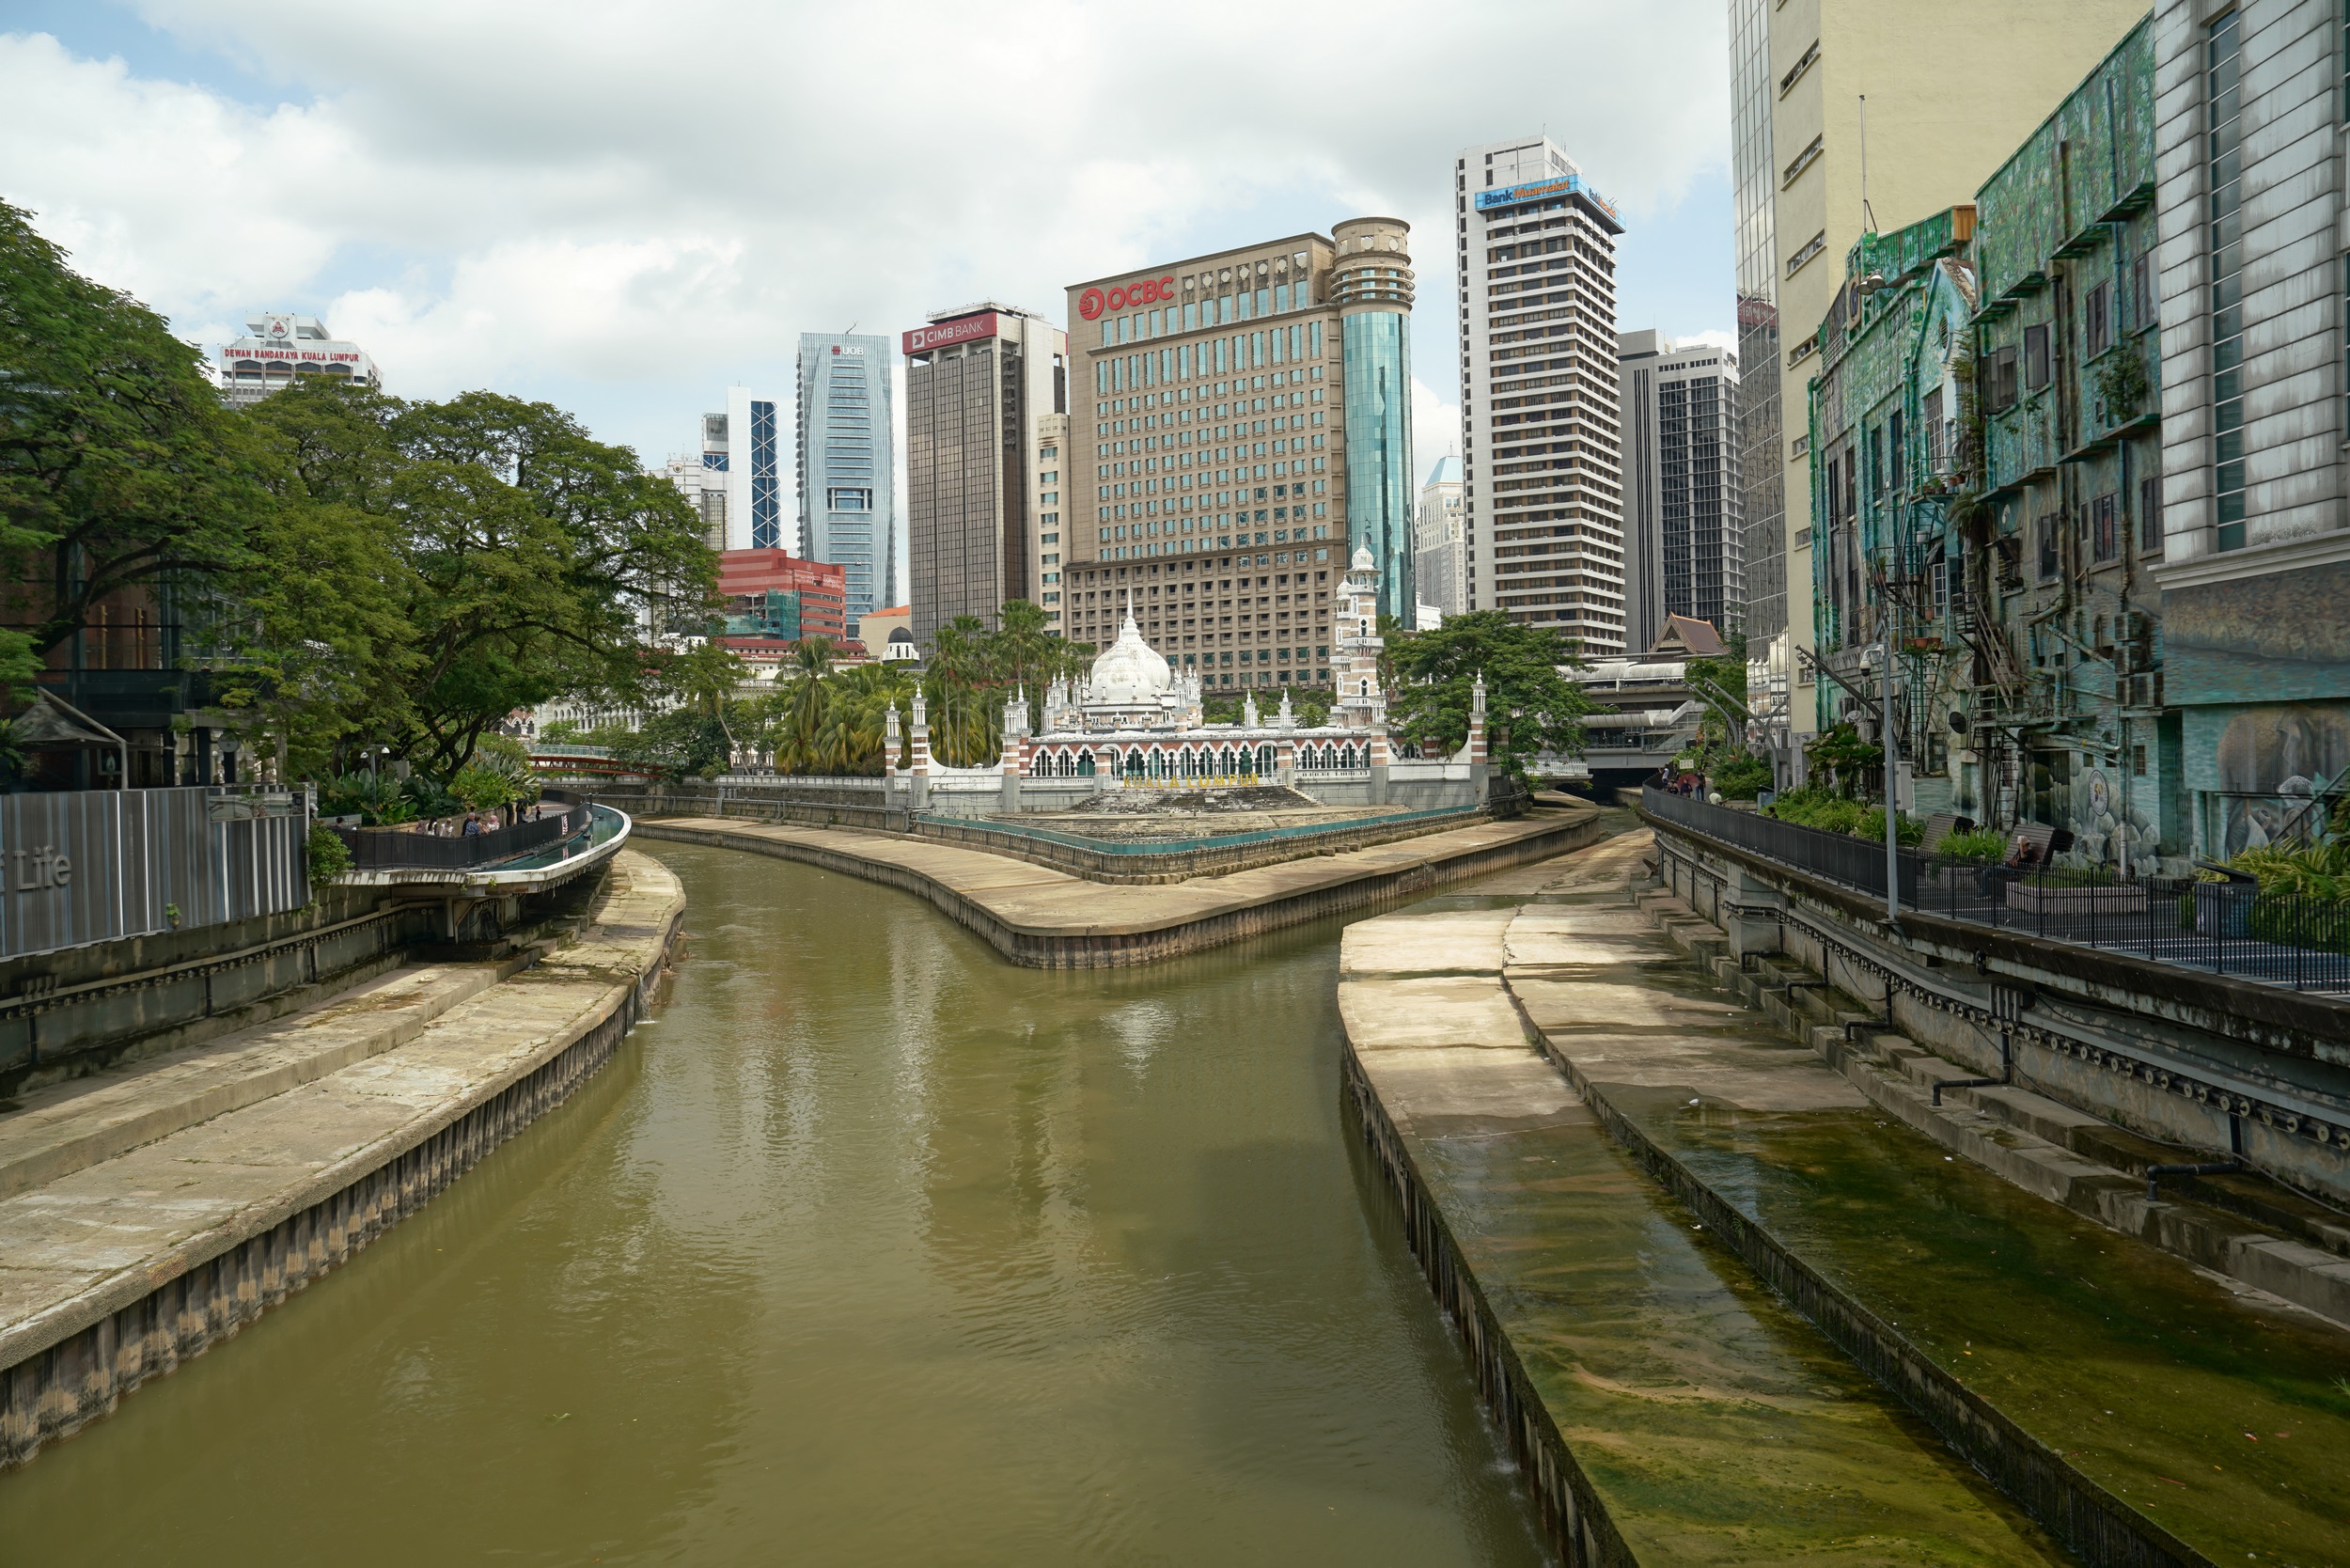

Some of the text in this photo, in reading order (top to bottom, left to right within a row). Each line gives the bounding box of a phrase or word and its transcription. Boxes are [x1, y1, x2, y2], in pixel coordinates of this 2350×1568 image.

[1485, 180, 1570, 205] Bank Muamalat
[1107, 276, 1174, 310] OCBC
[927, 321, 983, 342] CIMB BANK
[225, 349, 359, 362] DEWAN BANDARAYA KUALA LUMPUR
[842, 346, 864, 355] UOB
[1123, 774, 1259, 789] KUALA LUMPUR
[13, 845, 71, 890] Life
